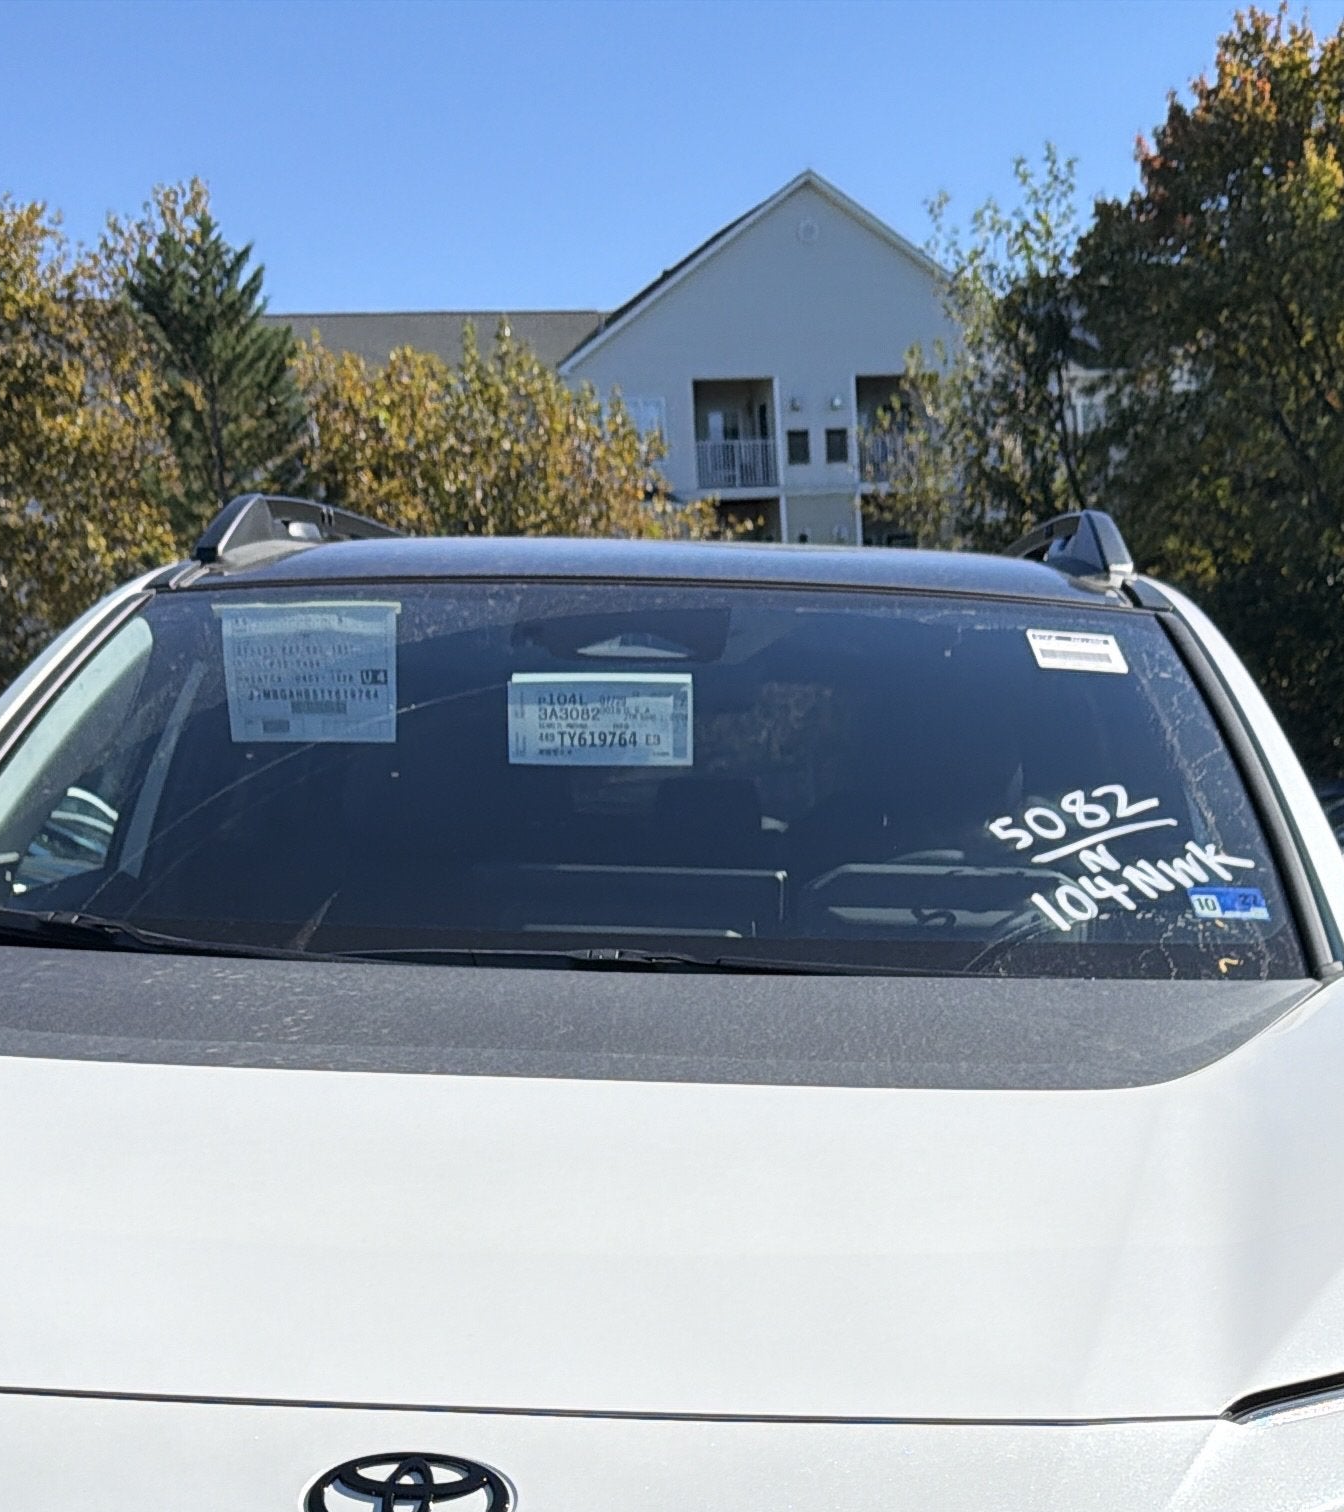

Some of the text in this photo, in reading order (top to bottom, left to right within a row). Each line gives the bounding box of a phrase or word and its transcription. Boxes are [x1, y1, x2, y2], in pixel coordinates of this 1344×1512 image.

[537, 706, 601, 722] 3A3082
[558, 730, 638, 748] TY619764
[988, 784, 1160, 850] 5082
[1196, 897, 1217, 912] 10
